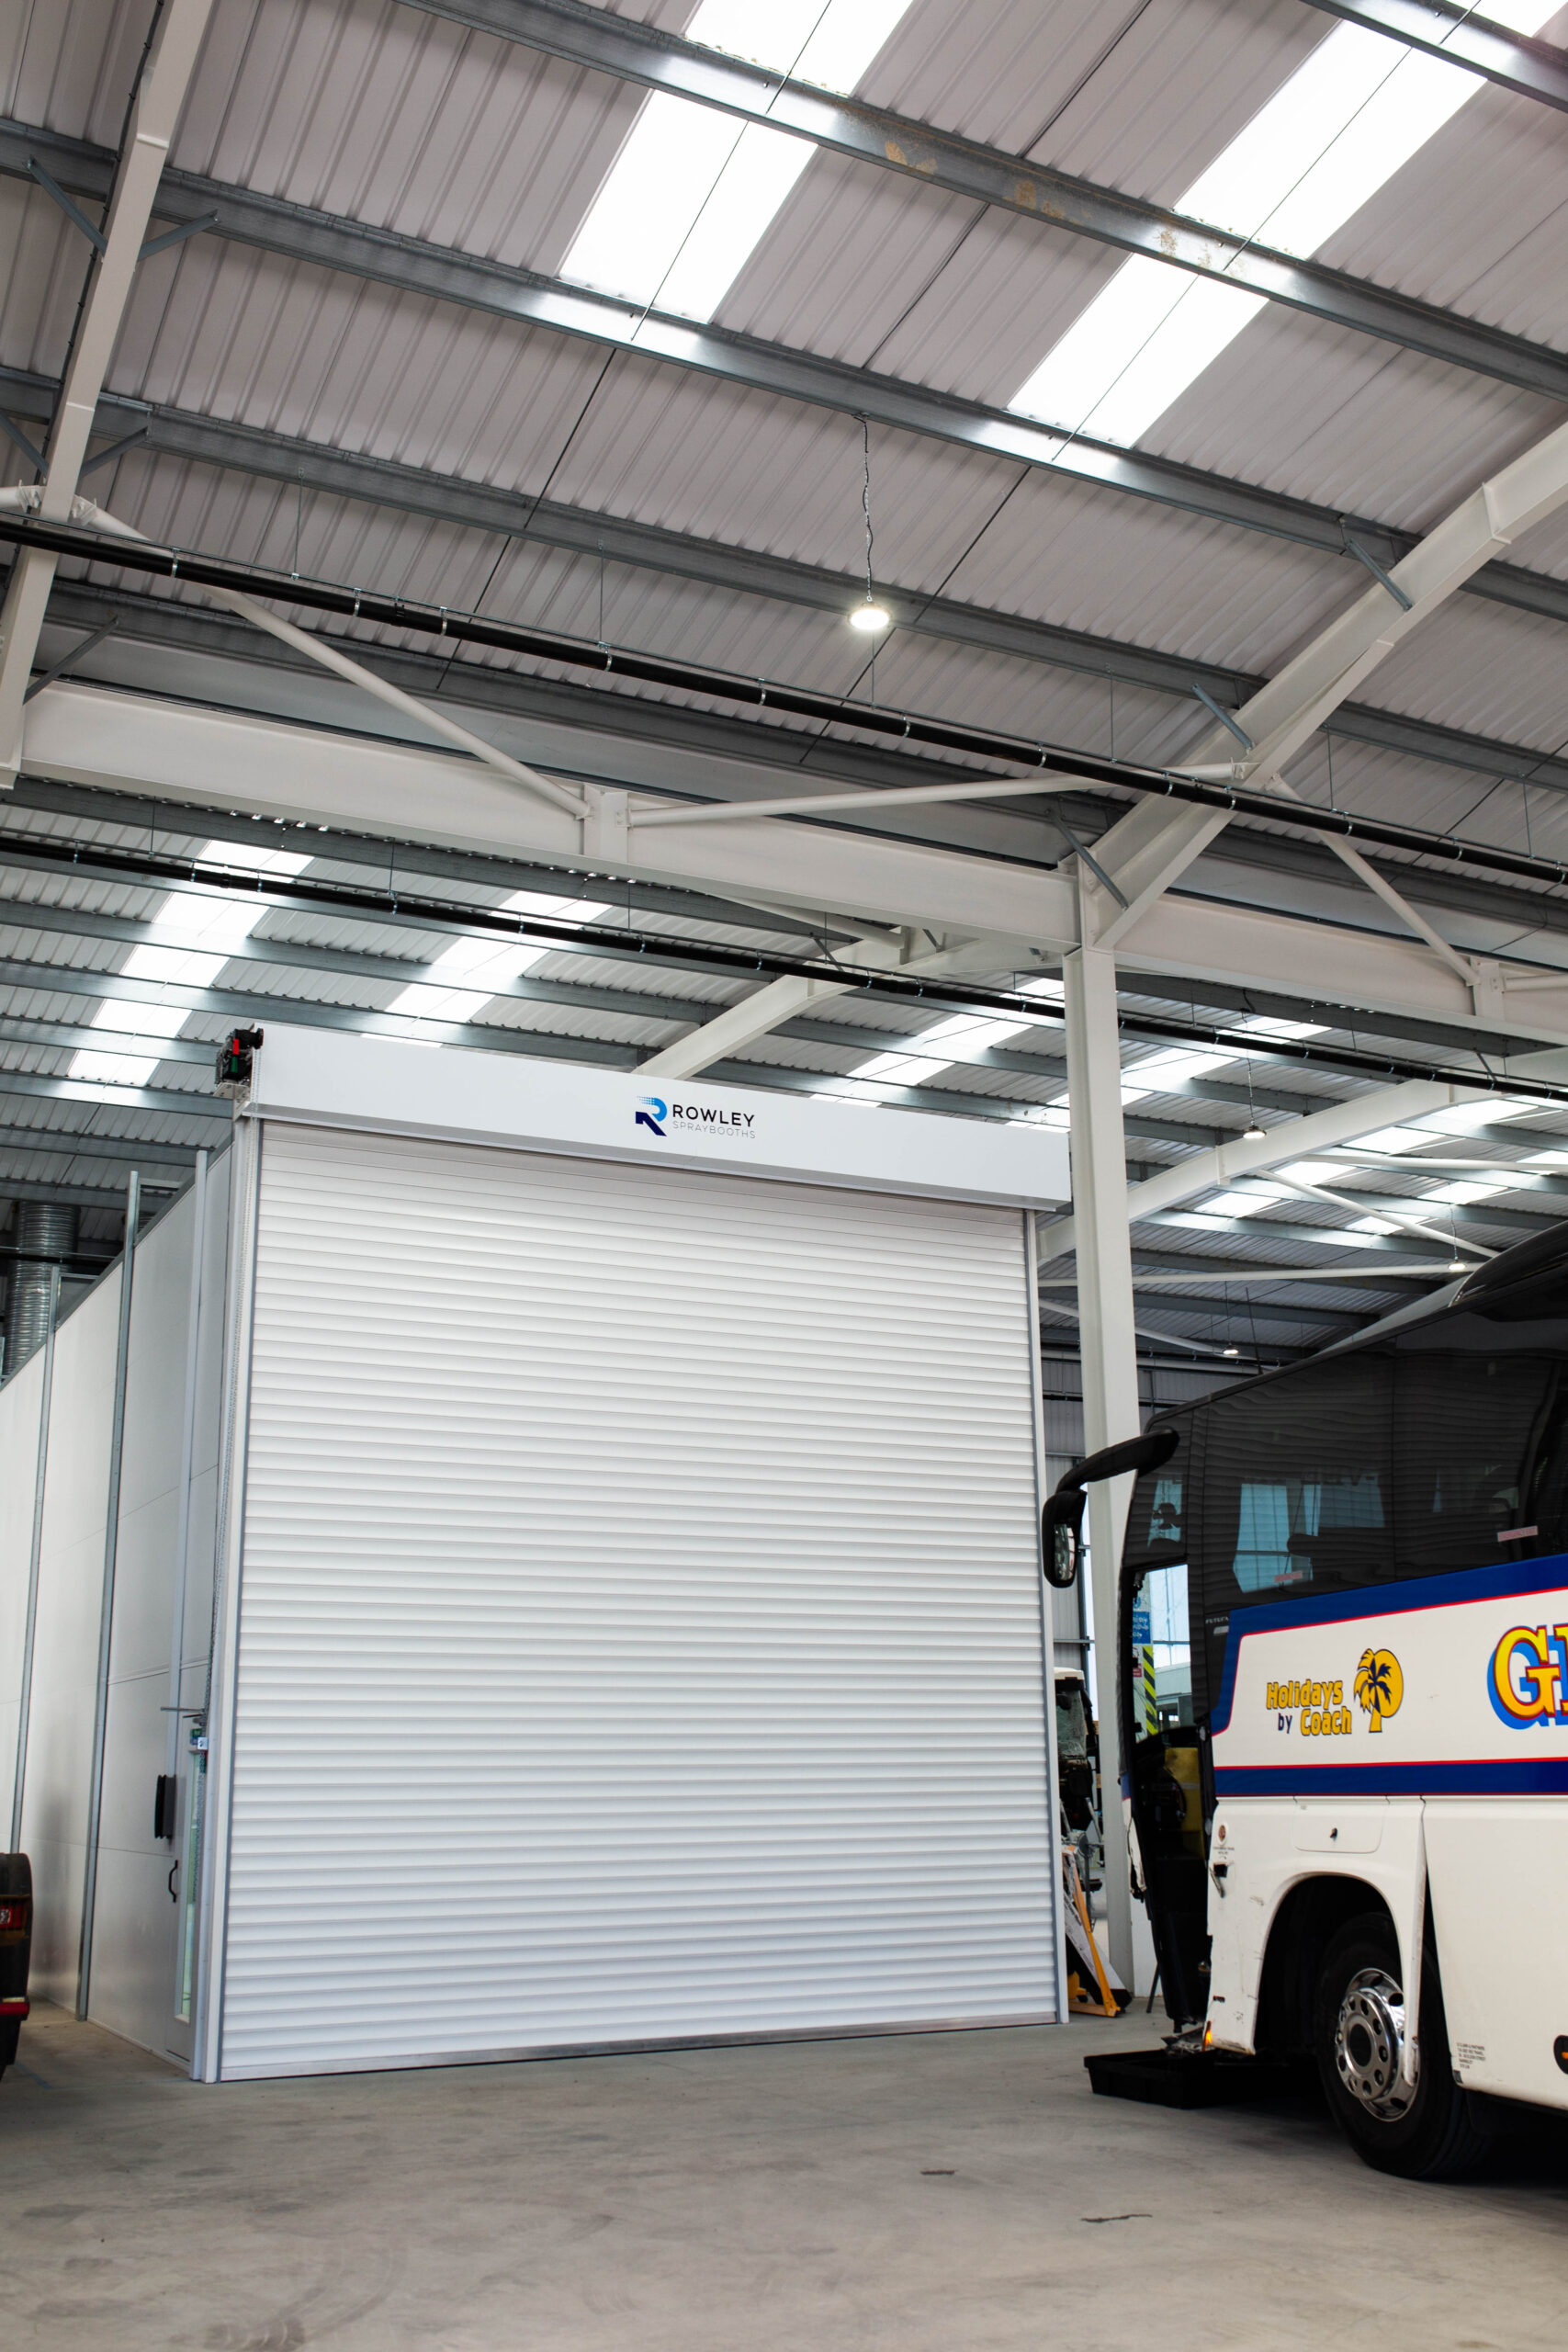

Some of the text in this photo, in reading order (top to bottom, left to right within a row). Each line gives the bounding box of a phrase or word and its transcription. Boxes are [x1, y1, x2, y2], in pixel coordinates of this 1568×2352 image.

[672, 1104, 755, 1127] ROWLEY
[672, 1120, 756, 1139] SPRAYBOOTHS
[1266, 1679, 1343, 1710] Holidays
[1278, 1707, 1352, 1736] by Coach
